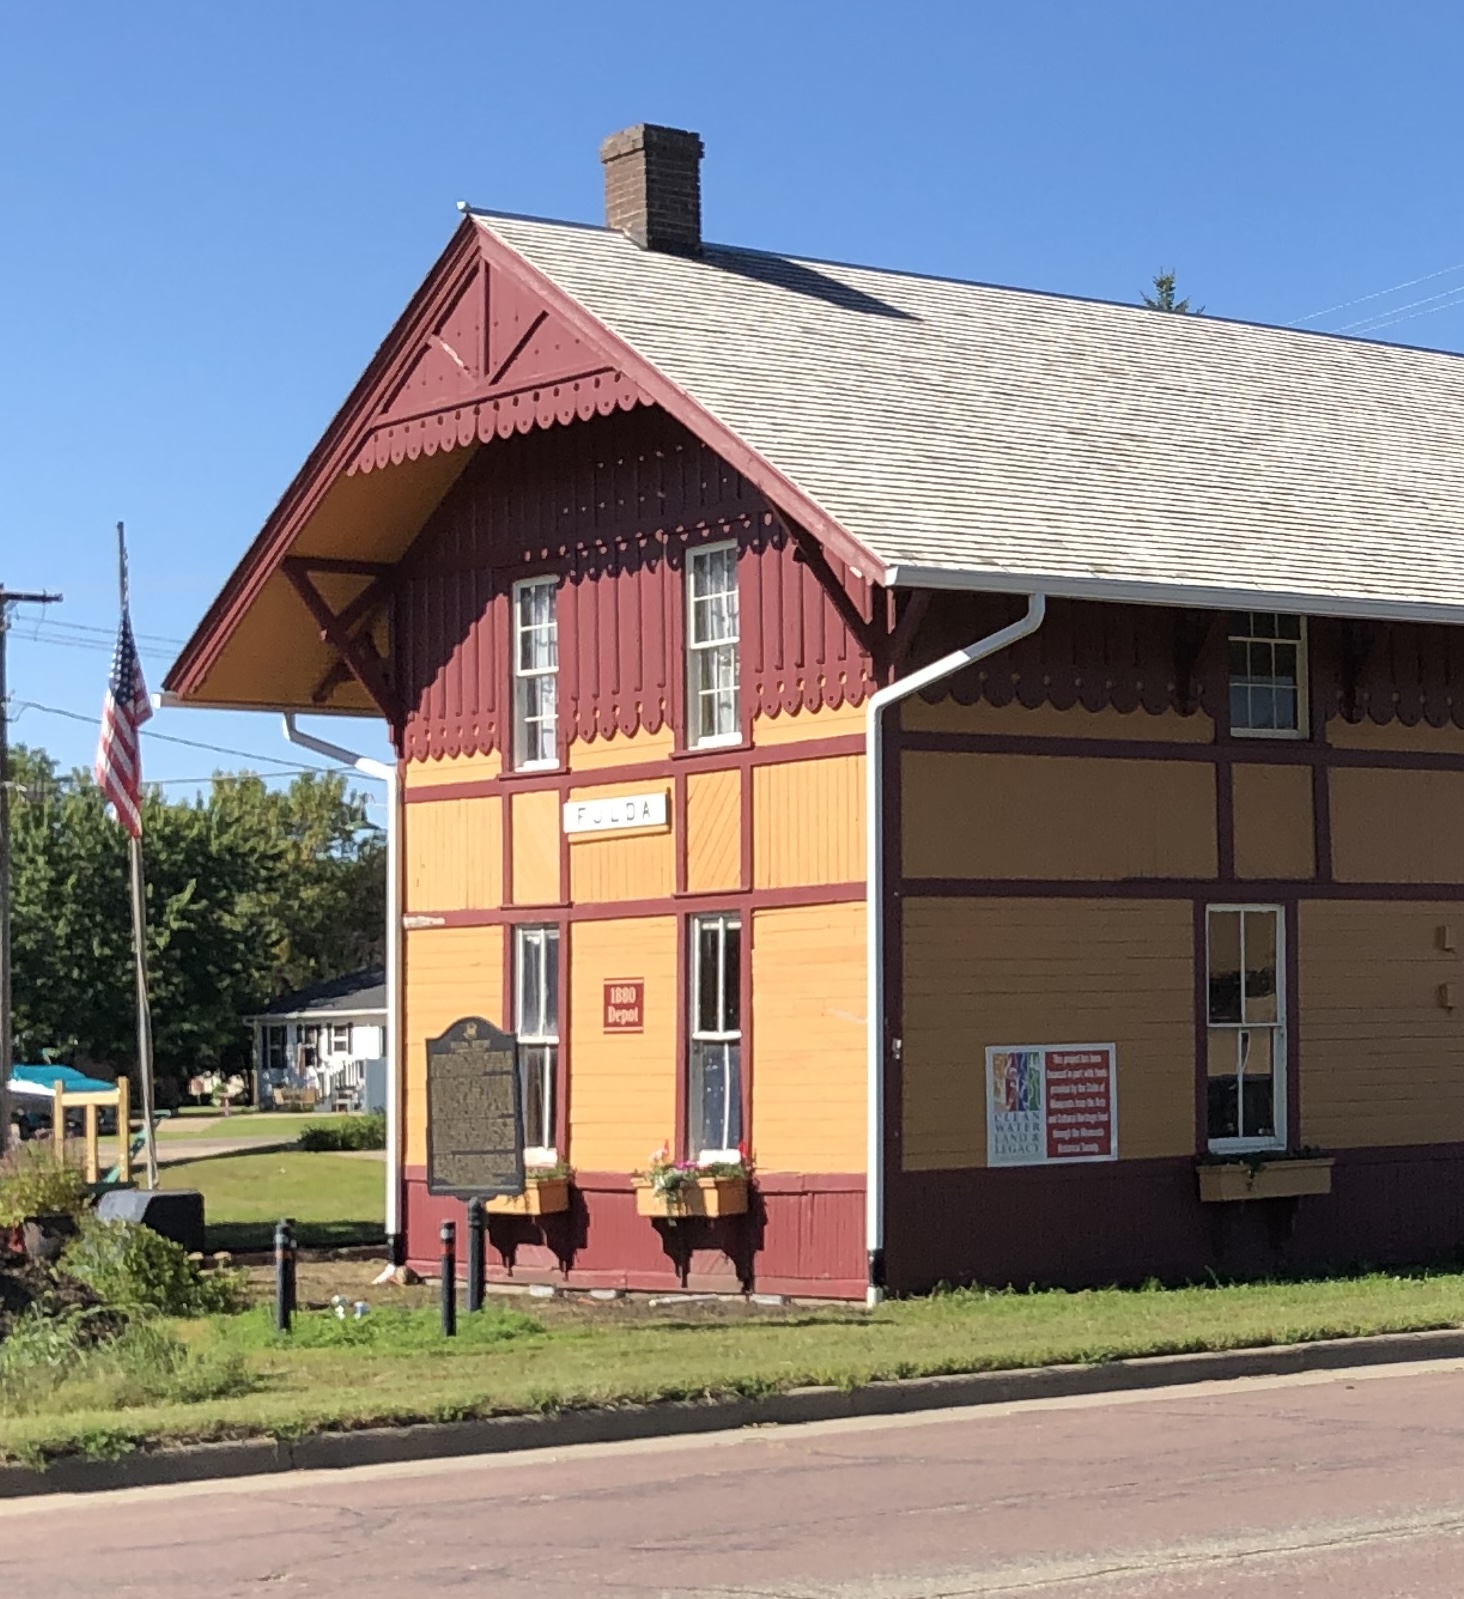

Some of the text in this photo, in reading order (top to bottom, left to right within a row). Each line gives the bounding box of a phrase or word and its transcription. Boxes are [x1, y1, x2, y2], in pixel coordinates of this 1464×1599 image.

[577, 800, 651, 826] FULDA
[610, 986, 637, 1004] 1880
[607, 1005, 639, 1025] Depot
[995, 1112, 1040, 1122] CLEAN
[995, 1122, 1040, 1132] WATER
[995, 1133, 1027, 1143] LAND
[995, 1143, 1039, 1154] LEGACY
